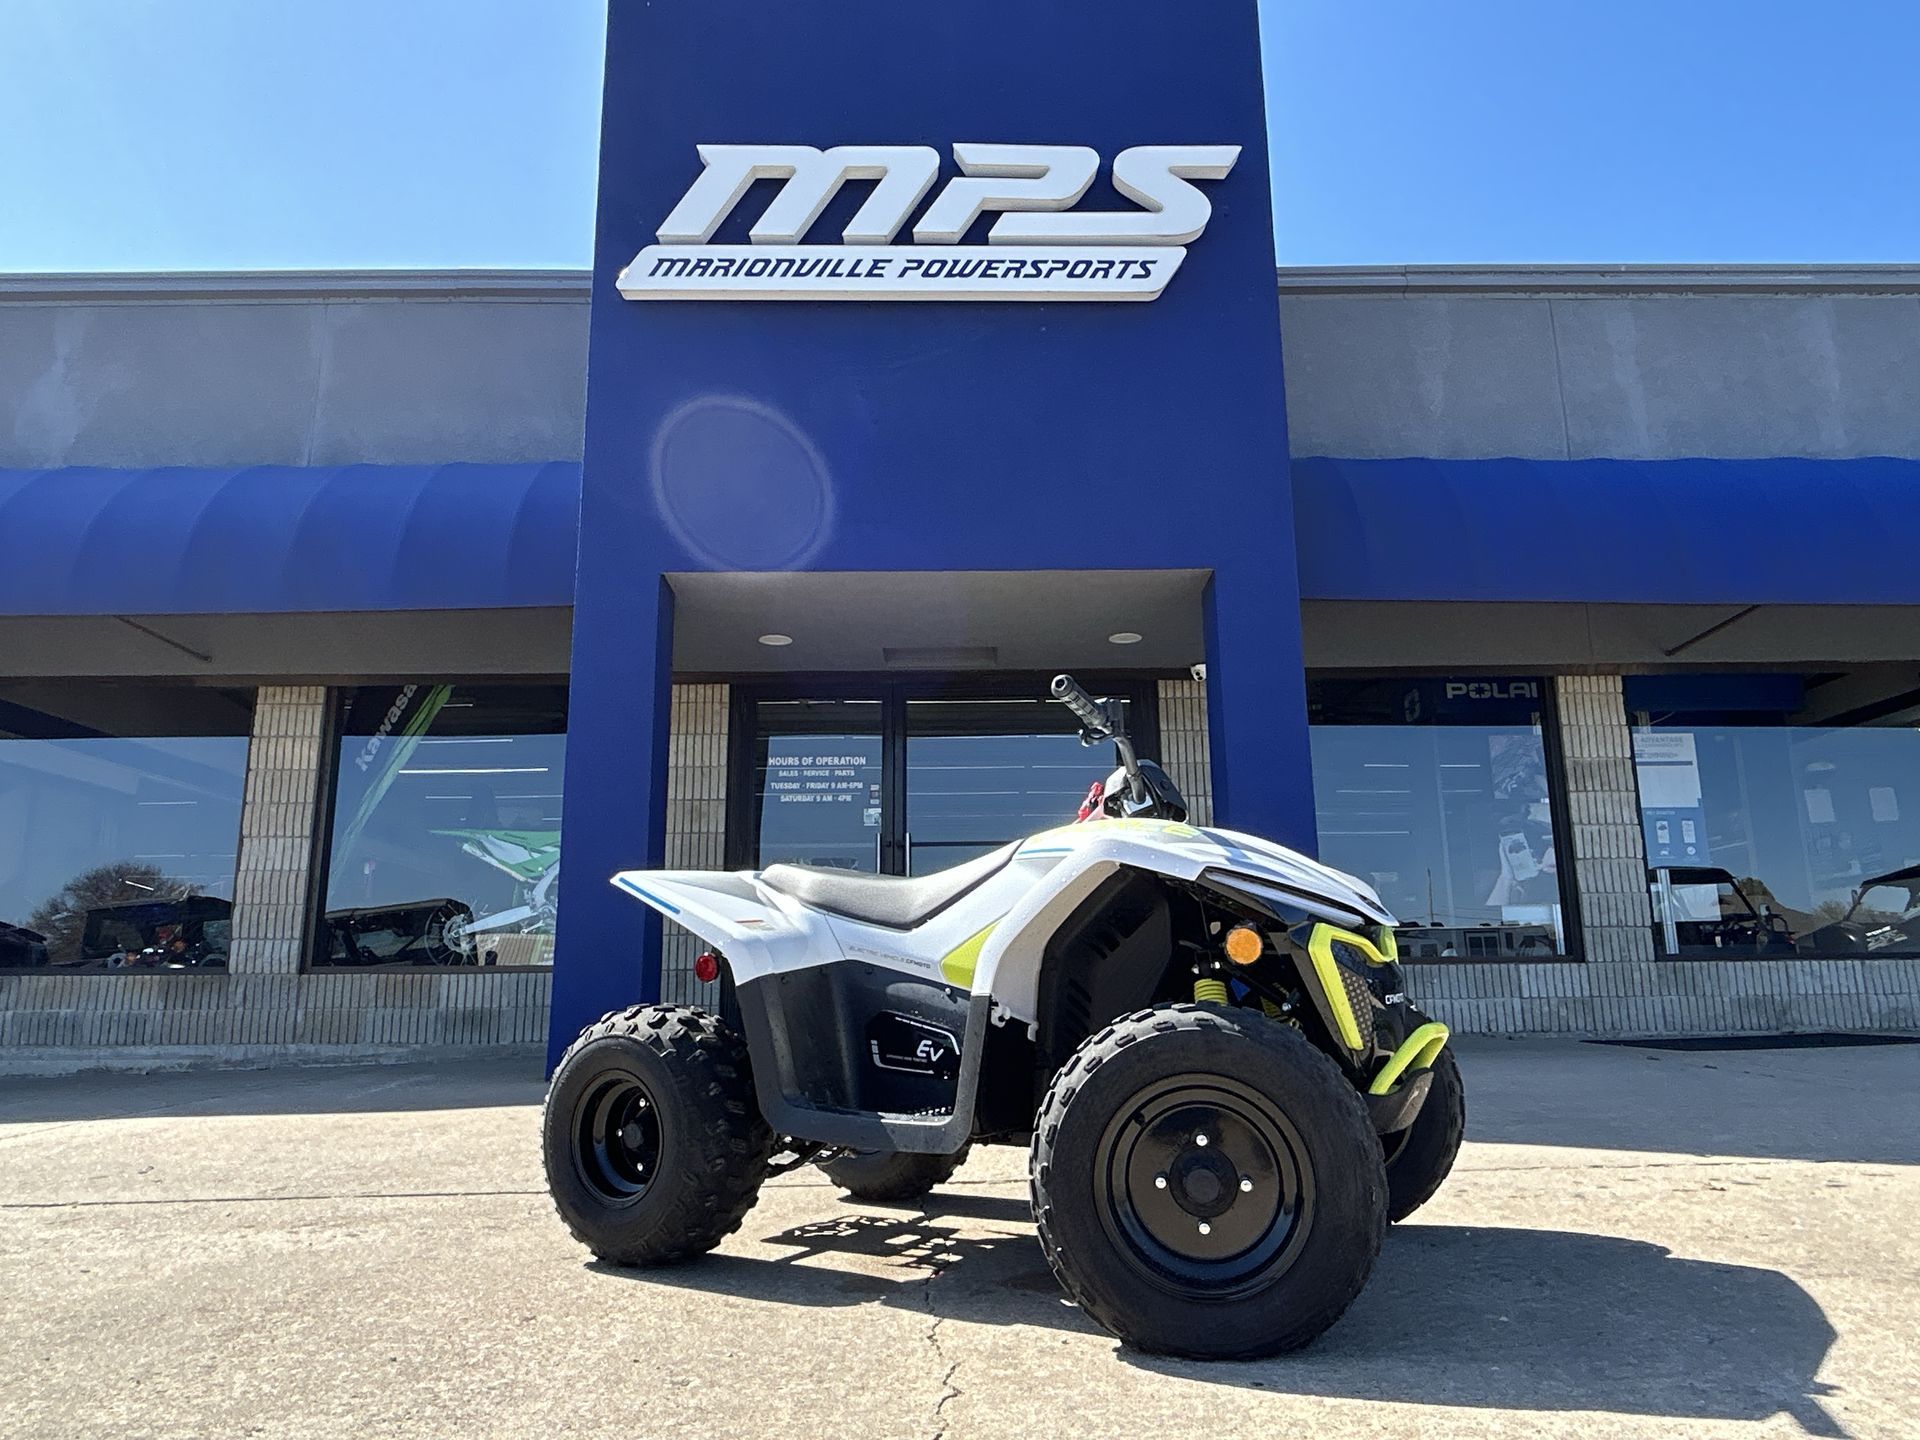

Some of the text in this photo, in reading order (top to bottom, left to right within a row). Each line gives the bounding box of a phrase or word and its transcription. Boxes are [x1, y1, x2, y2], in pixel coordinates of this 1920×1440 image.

[655, 142, 1243, 245] MPS
[648, 257, 1159, 280] MARIONVILLE POWERSPORTS
[768, 756, 866, 766] HOURS OF OPERATION
[916, 1039, 944, 1062] EV
